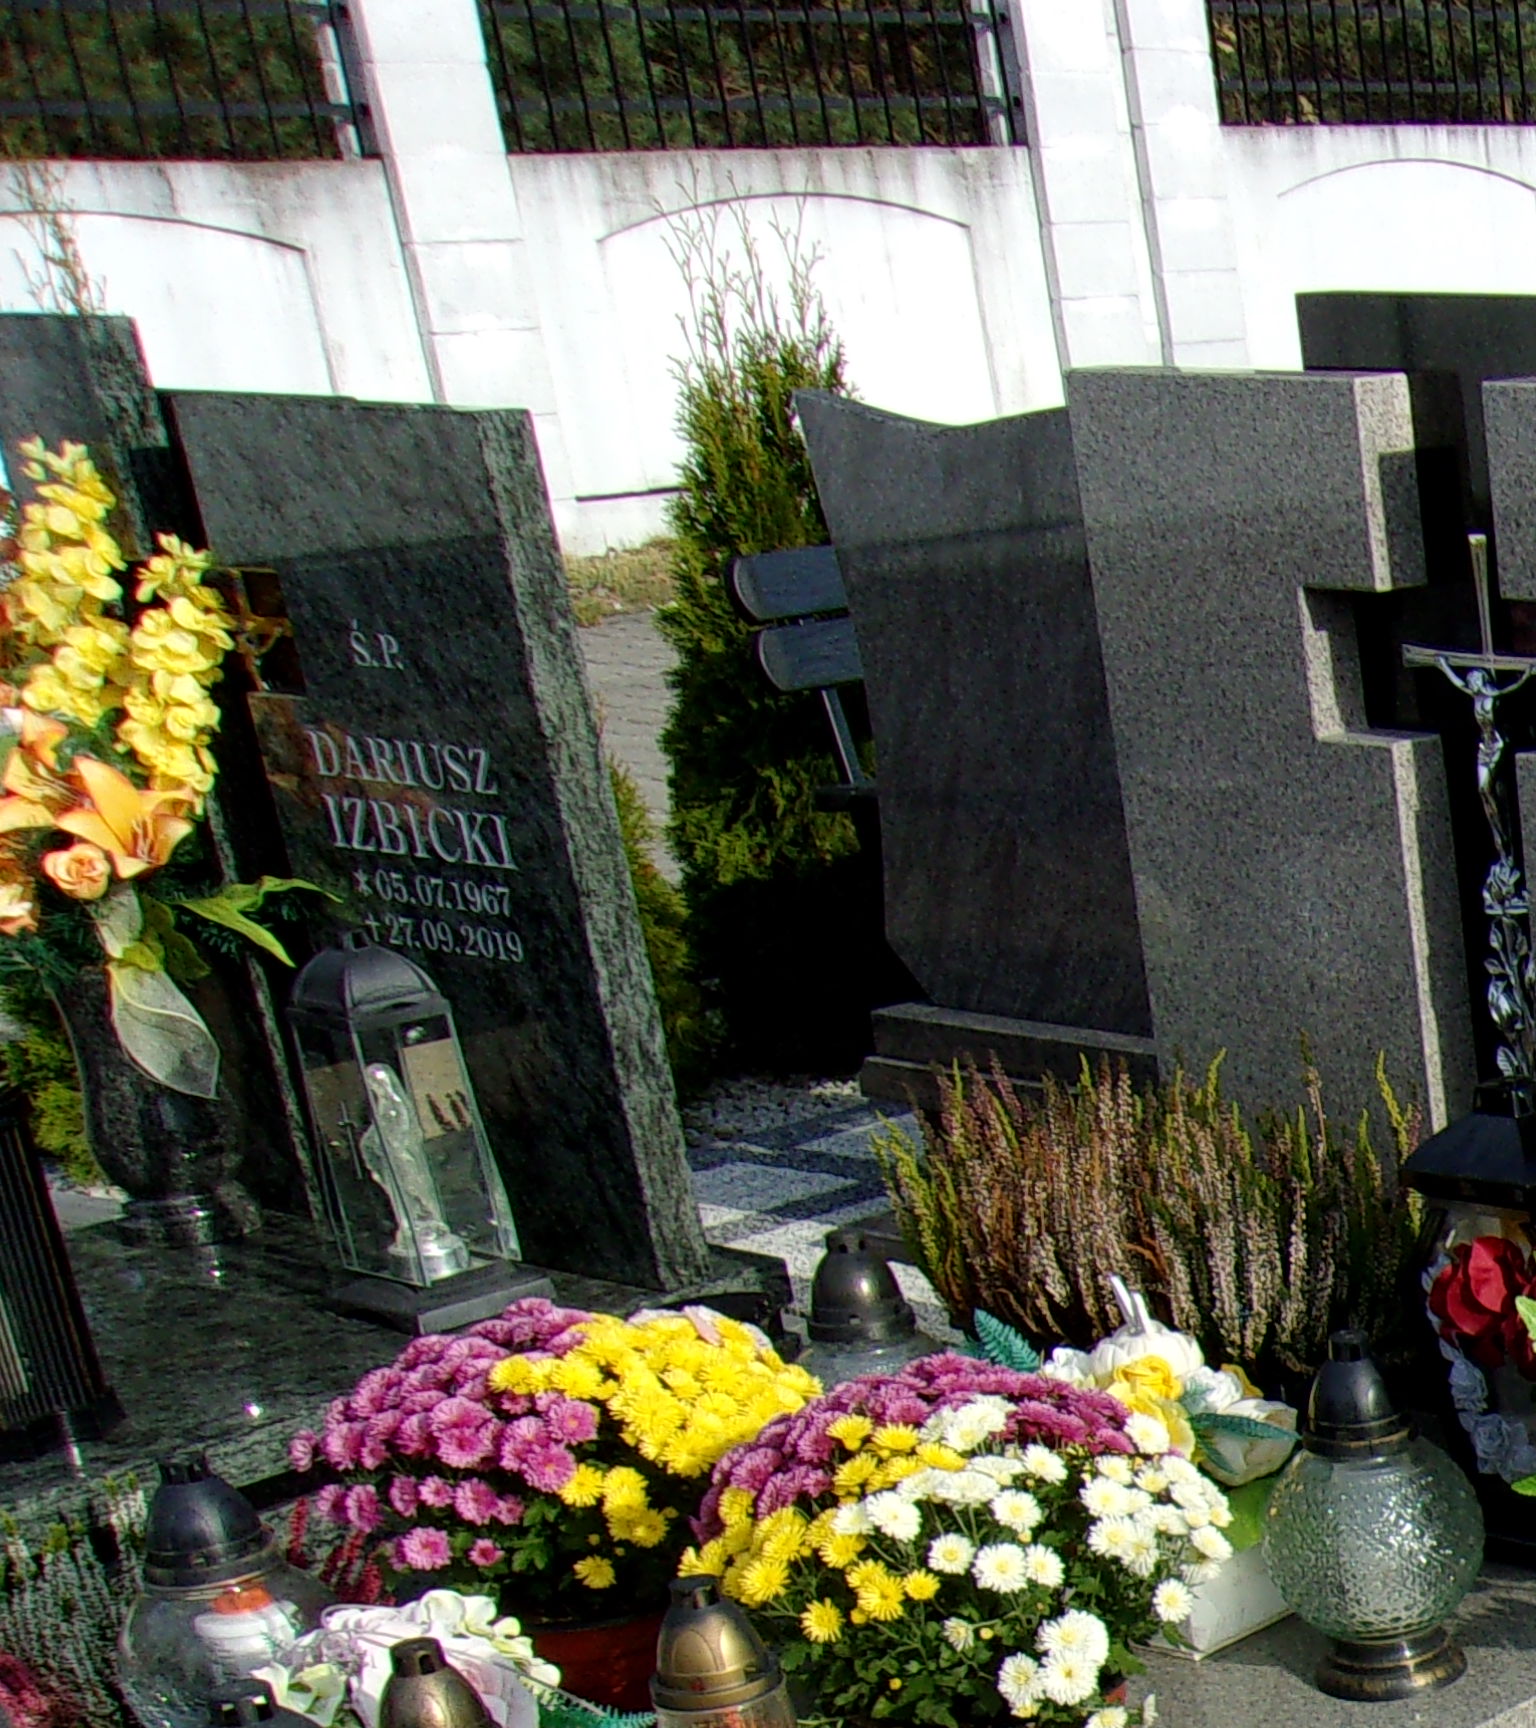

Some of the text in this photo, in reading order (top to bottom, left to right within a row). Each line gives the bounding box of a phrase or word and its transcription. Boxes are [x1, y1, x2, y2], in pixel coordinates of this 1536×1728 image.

[350, 619, 405, 670] Ś.P.
[304, 729, 499, 796] DARIUSZ
[322, 793, 521, 872] IZBICKI
[375, 868, 511, 918] 05.07.1967
[385, 913, 525, 963] 27.09.2019
